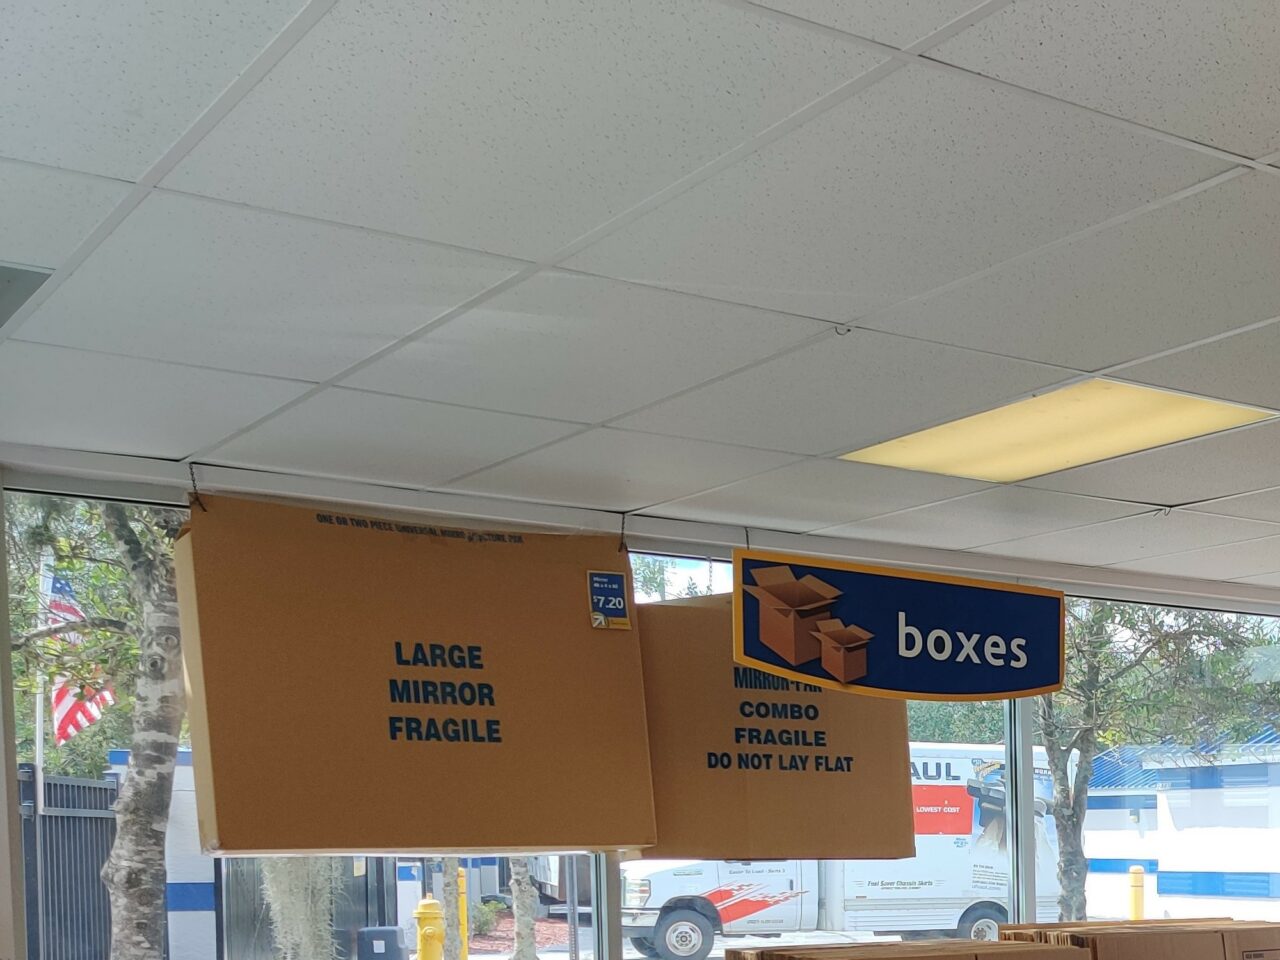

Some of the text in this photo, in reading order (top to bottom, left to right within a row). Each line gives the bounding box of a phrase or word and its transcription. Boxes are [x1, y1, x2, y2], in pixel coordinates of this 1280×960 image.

[350, 518, 369, 529] TWO
[593, 595, 624, 609] $7.20
[898, 611, 1028, 669] boxes
[394, 642, 483, 669] LARGE
[733, 666, 823, 693] MIRROR-
[389, 680, 495, 706] MIRROR
[740, 701, 819, 720] COMBO
[389, 716, 502, 742] FRAGILE
[734, 728, 827, 747] FRAGILE
[707, 752, 854, 773] DO NOT LAY FLAT
